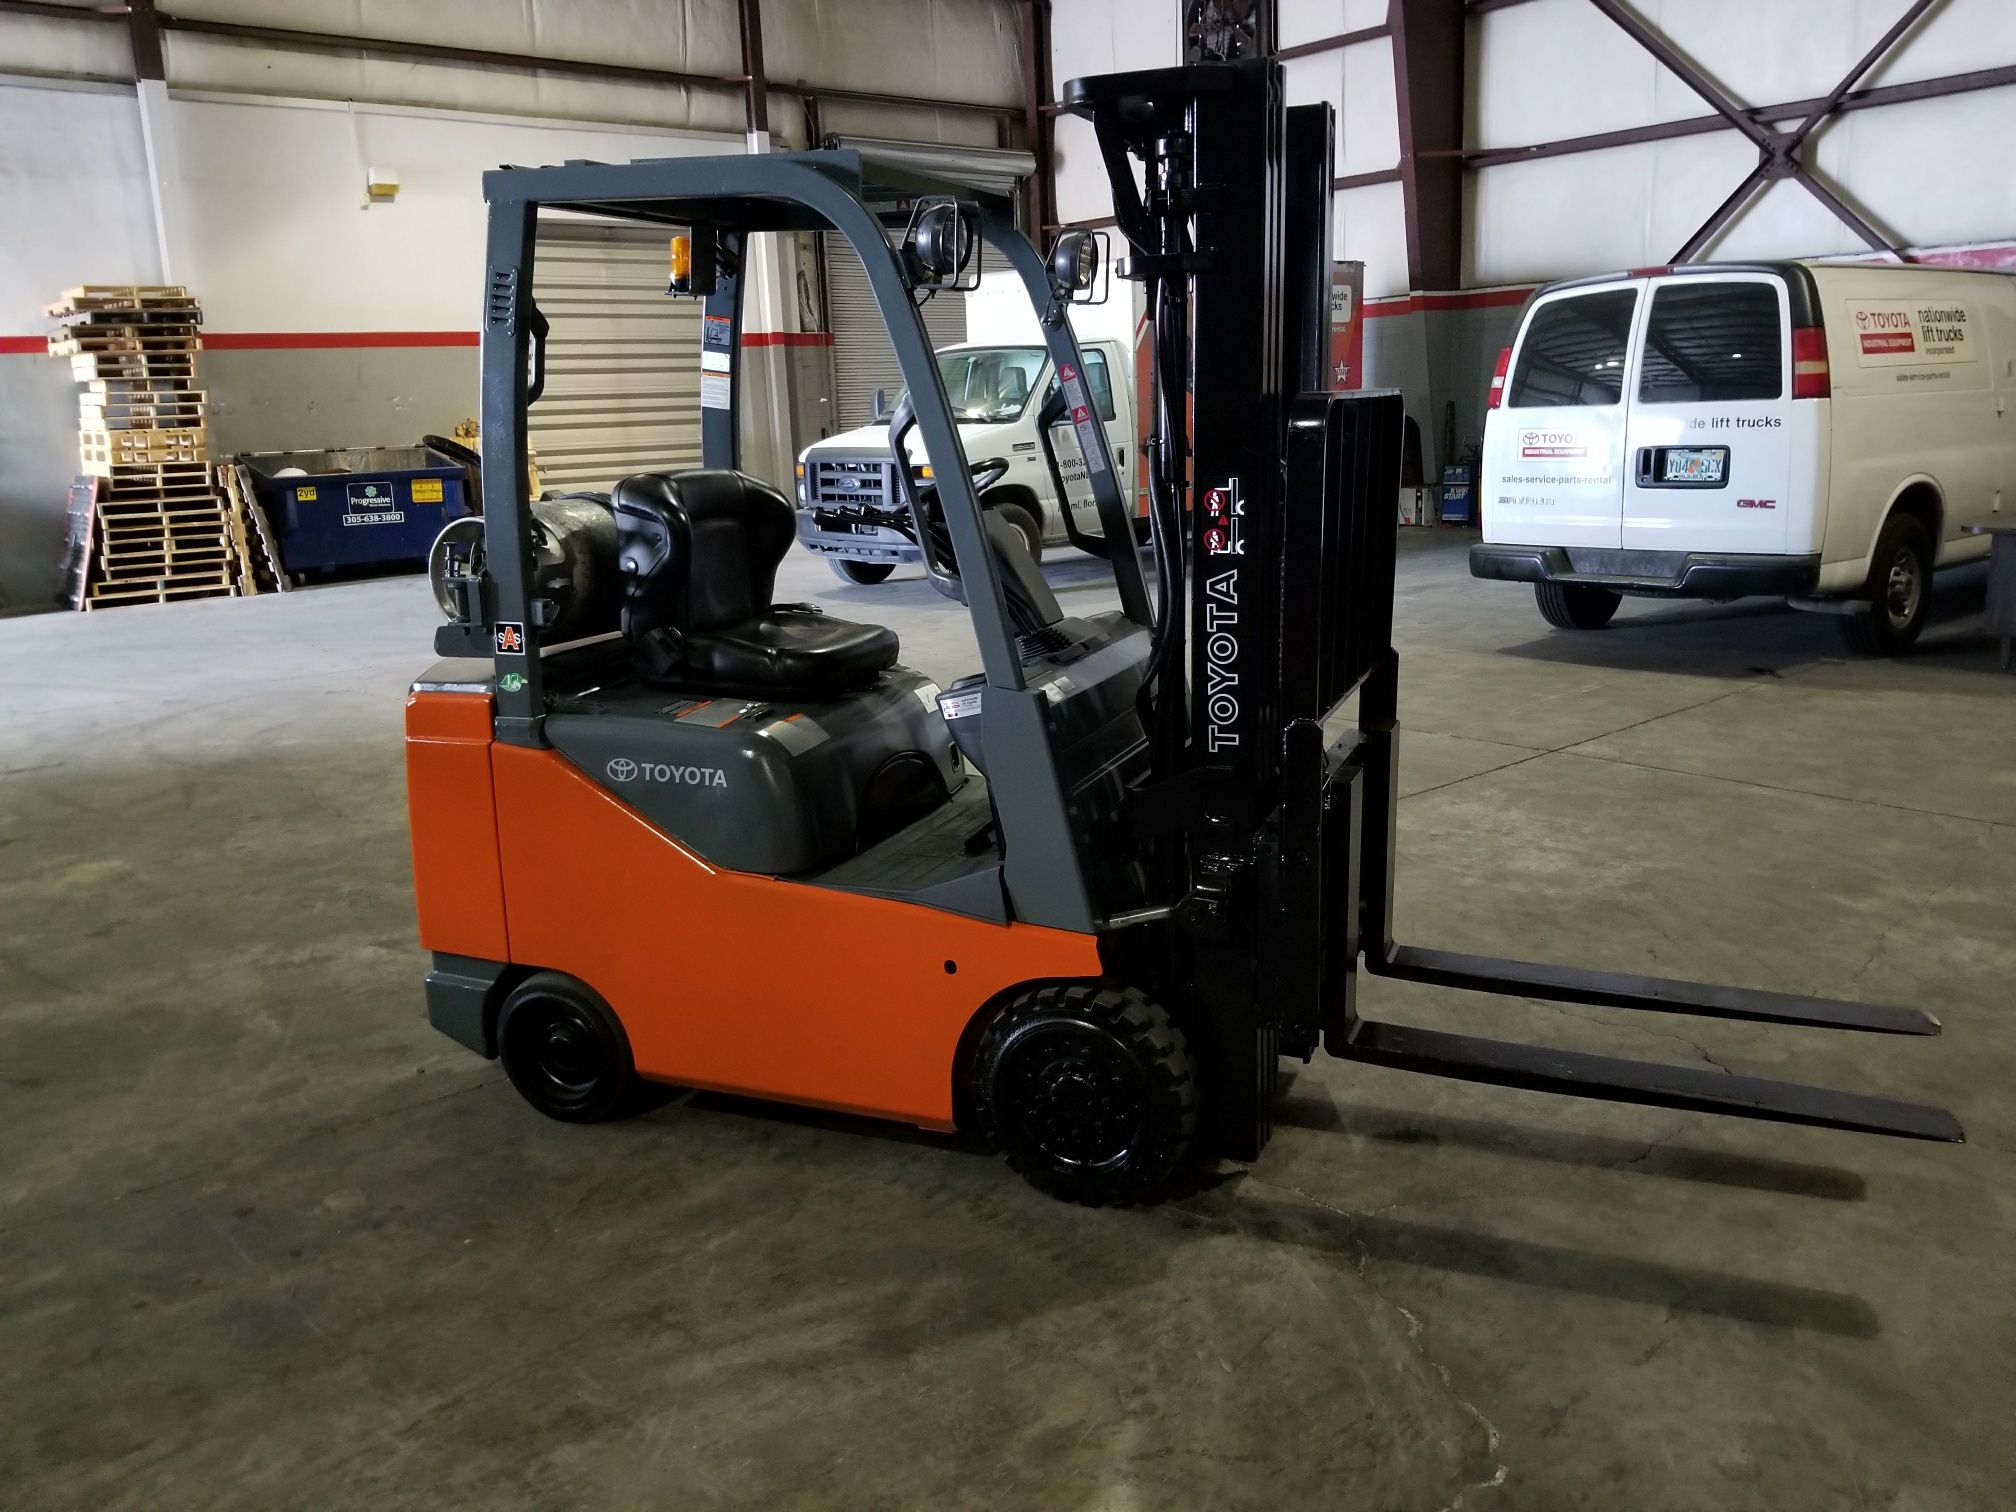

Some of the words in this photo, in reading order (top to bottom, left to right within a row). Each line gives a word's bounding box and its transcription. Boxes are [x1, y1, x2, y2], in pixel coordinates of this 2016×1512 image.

[1870, 312, 1911, 328] TOYOTA
[1917, 306, 1967, 323] nationwide
[1921, 325, 1935, 342] lift
[1936, 325, 1964, 342] trucks
[1711, 418, 1730, 428] lift
[1736, 416, 1782, 428] trucks
[1541, 433, 1577, 444] TOYO
[298, 488, 315, 499] 2yd
[350, 495, 391, 507] Progressive
[1736, 499, 1776, 509] GMC
[346, 513, 400, 524] 305-638-3800
[497, 626, 521, 651] SAS
[1206, 568, 1239, 753] TOYOTA
[641, 763, 727, 788] TOYOTA
